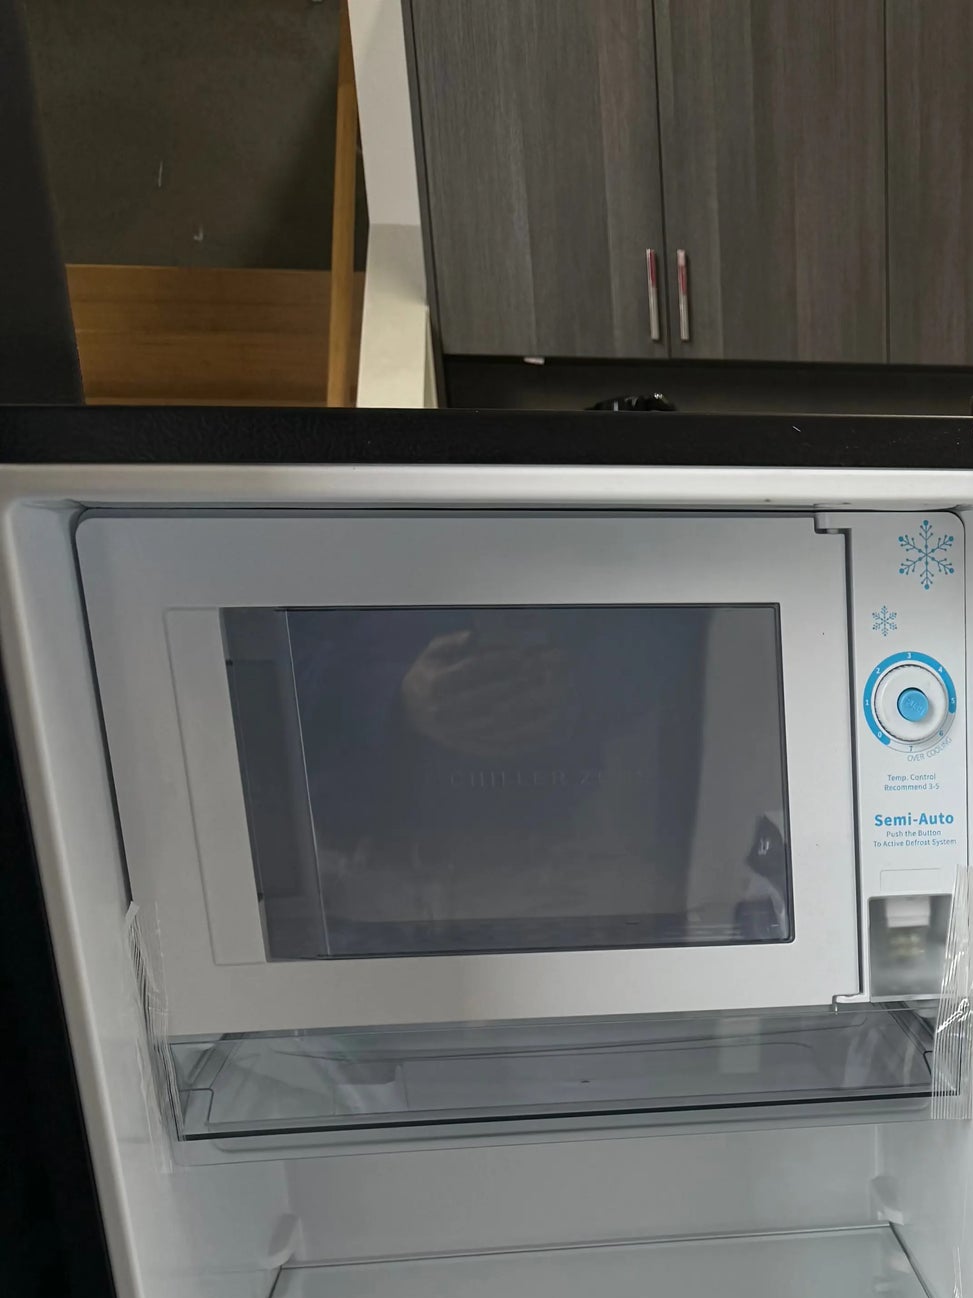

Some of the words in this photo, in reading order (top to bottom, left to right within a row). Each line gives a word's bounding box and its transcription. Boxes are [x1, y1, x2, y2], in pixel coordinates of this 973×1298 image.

[907, 753, 925, 762] OVER
[887, 774, 909, 782] Temp.
[910, 773, 936, 781] Control
[884, 783, 927, 791] Recommend
[874, 811, 954, 827] Semi-Auto
[918, 829, 942, 837] Button
[883, 839, 904, 847] Active
[905, 838, 930, 847] Defrost
[932, 838, 957, 847] System
